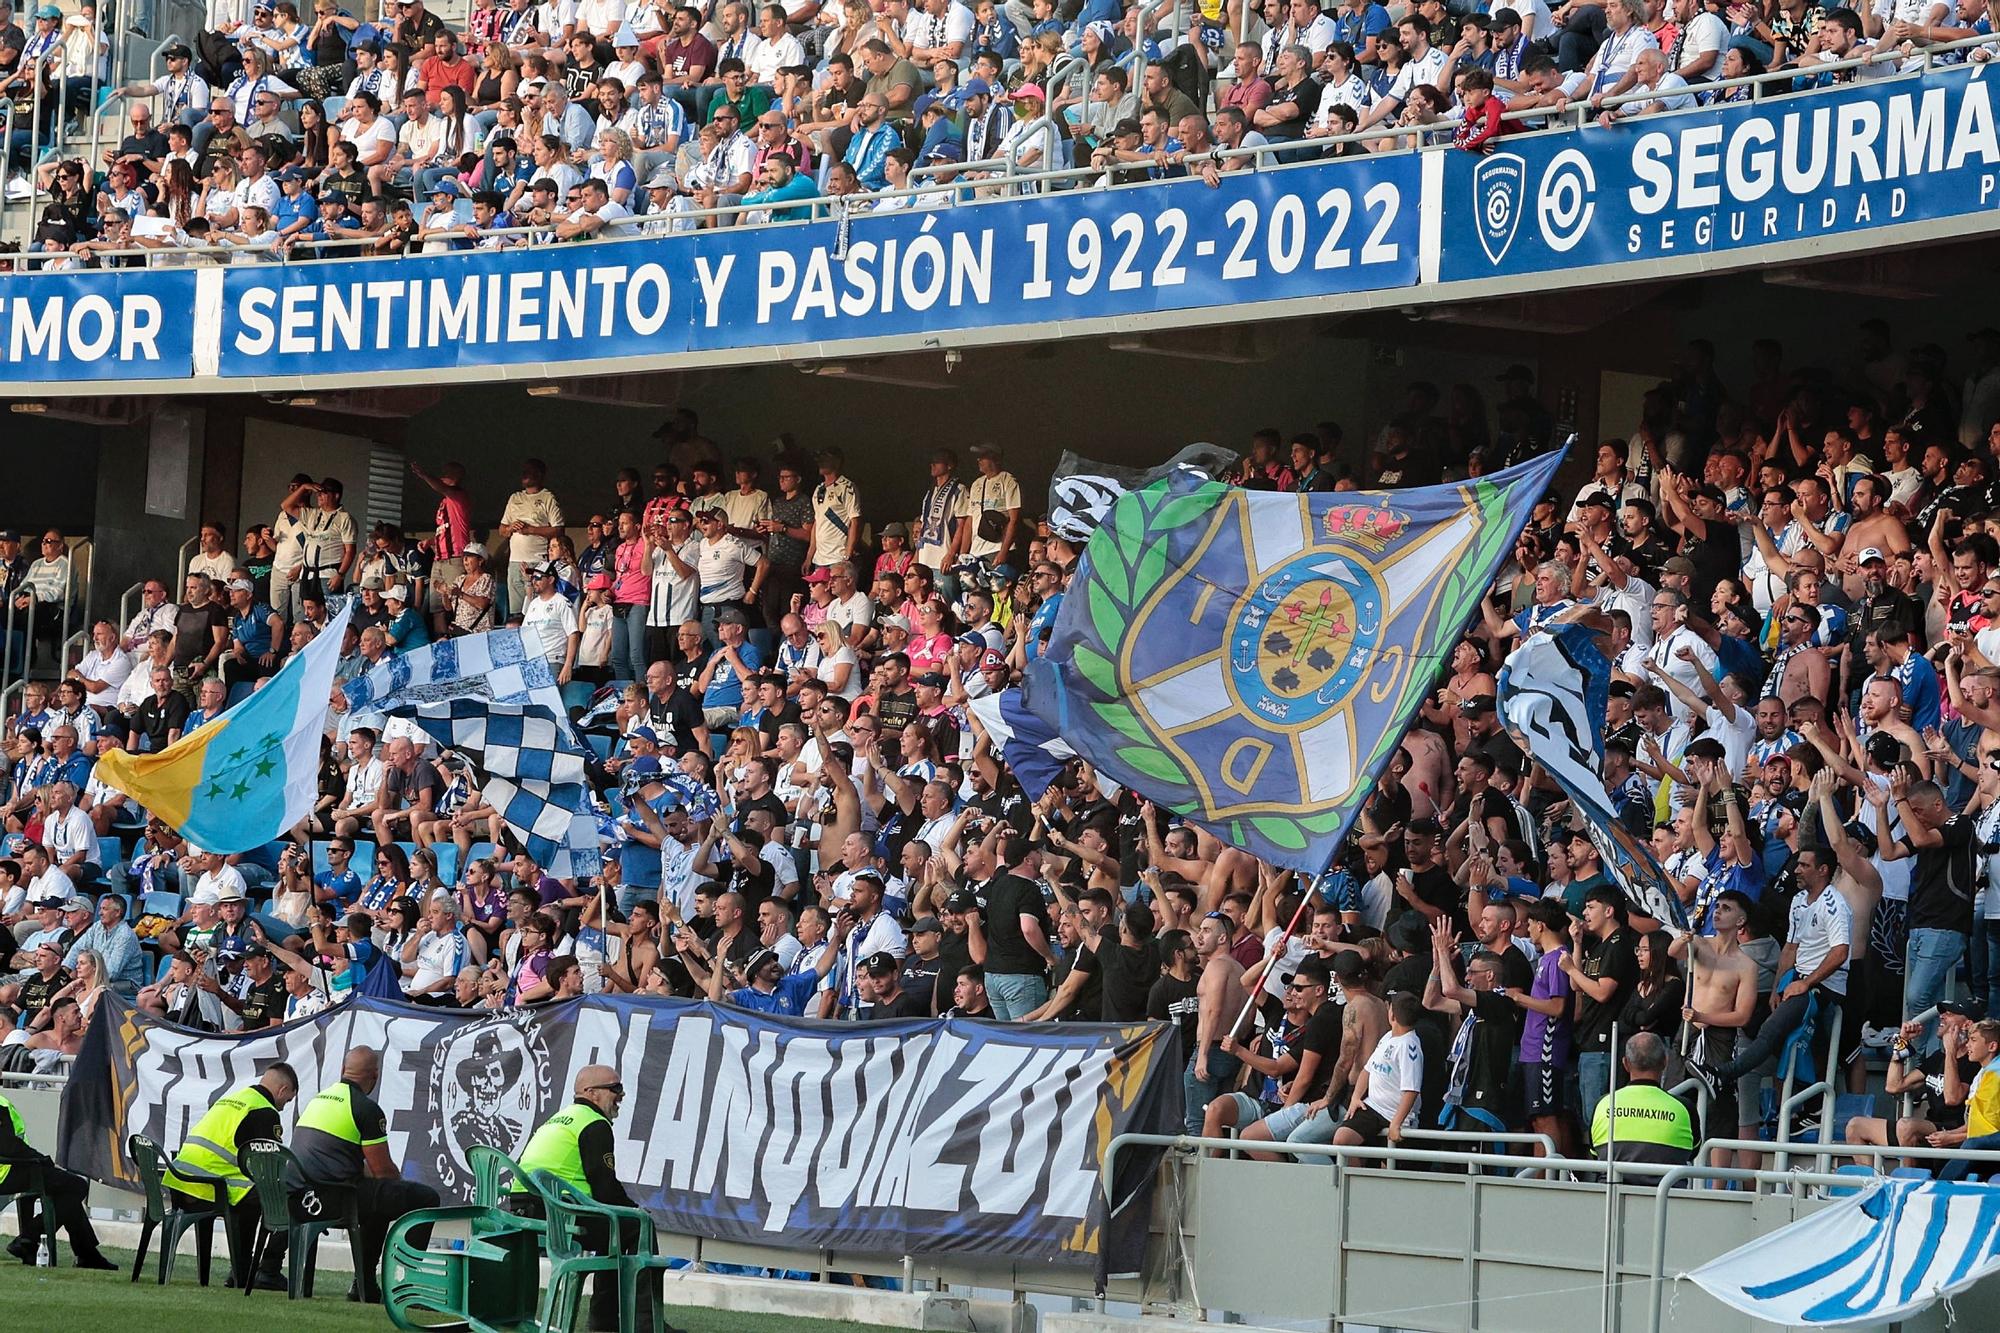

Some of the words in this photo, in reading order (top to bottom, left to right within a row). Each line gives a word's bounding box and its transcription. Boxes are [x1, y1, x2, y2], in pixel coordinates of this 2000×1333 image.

[1628, 64, 2000, 215] SEGURMÁ
[1628, 187, 1905, 253] SEGURIDAD
[235, 263, 671, 356] SENTIMIENTO
[695, 254, 736, 328] Y
[756, 214, 994, 325] PASIÓN
[1022, 182, 1401, 300] 1922-2022
[0, 293, 162, 362] MOR
[447, 1082, 457, 1110] 19
[518, 1082, 531, 1110] 86
[250, 1142, 281, 1153] POLICIA
